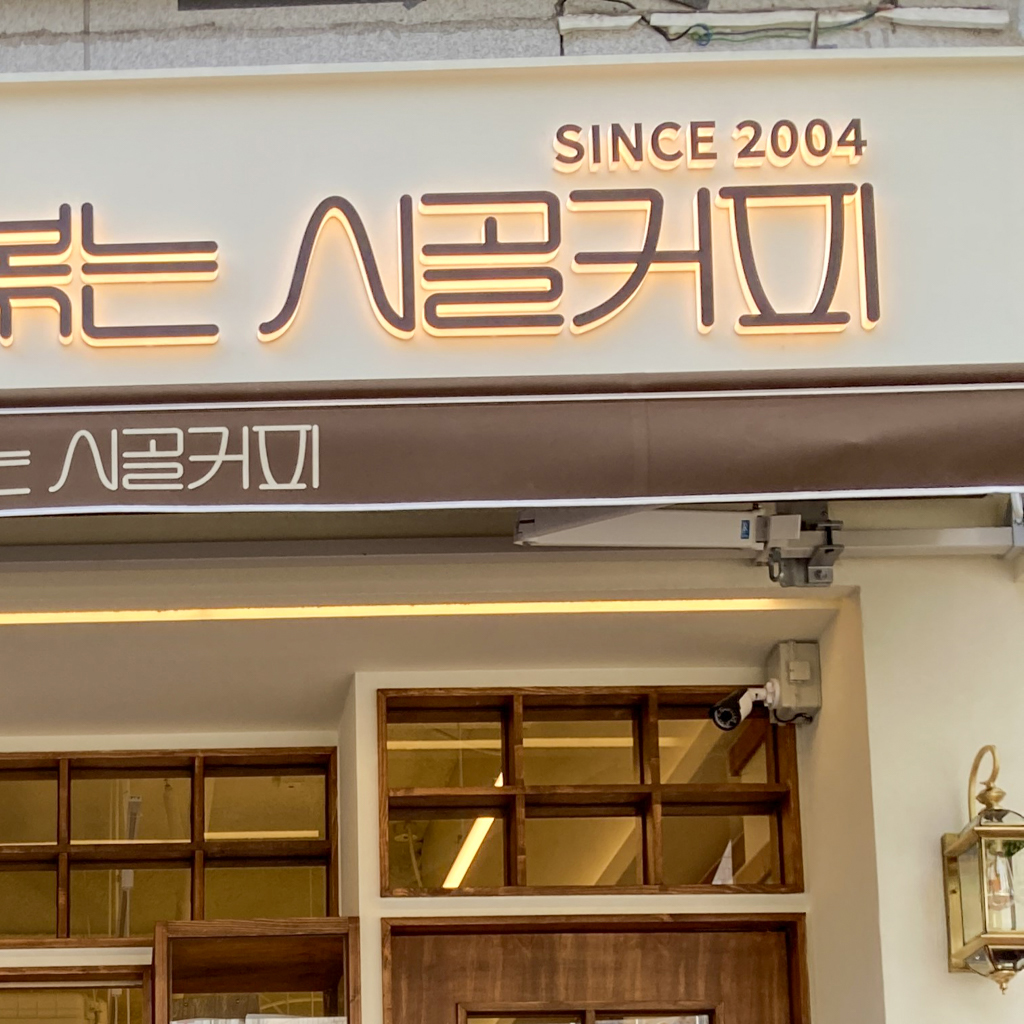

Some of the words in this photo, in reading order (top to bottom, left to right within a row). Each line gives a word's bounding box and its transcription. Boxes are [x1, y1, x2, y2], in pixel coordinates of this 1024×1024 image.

[557, 122, 714, 162] SINCE
[738, 118, 867, 158] 2004
[260, 183, 879, 333] 시골커피
[49, 425, 318, 492] 시골커피
